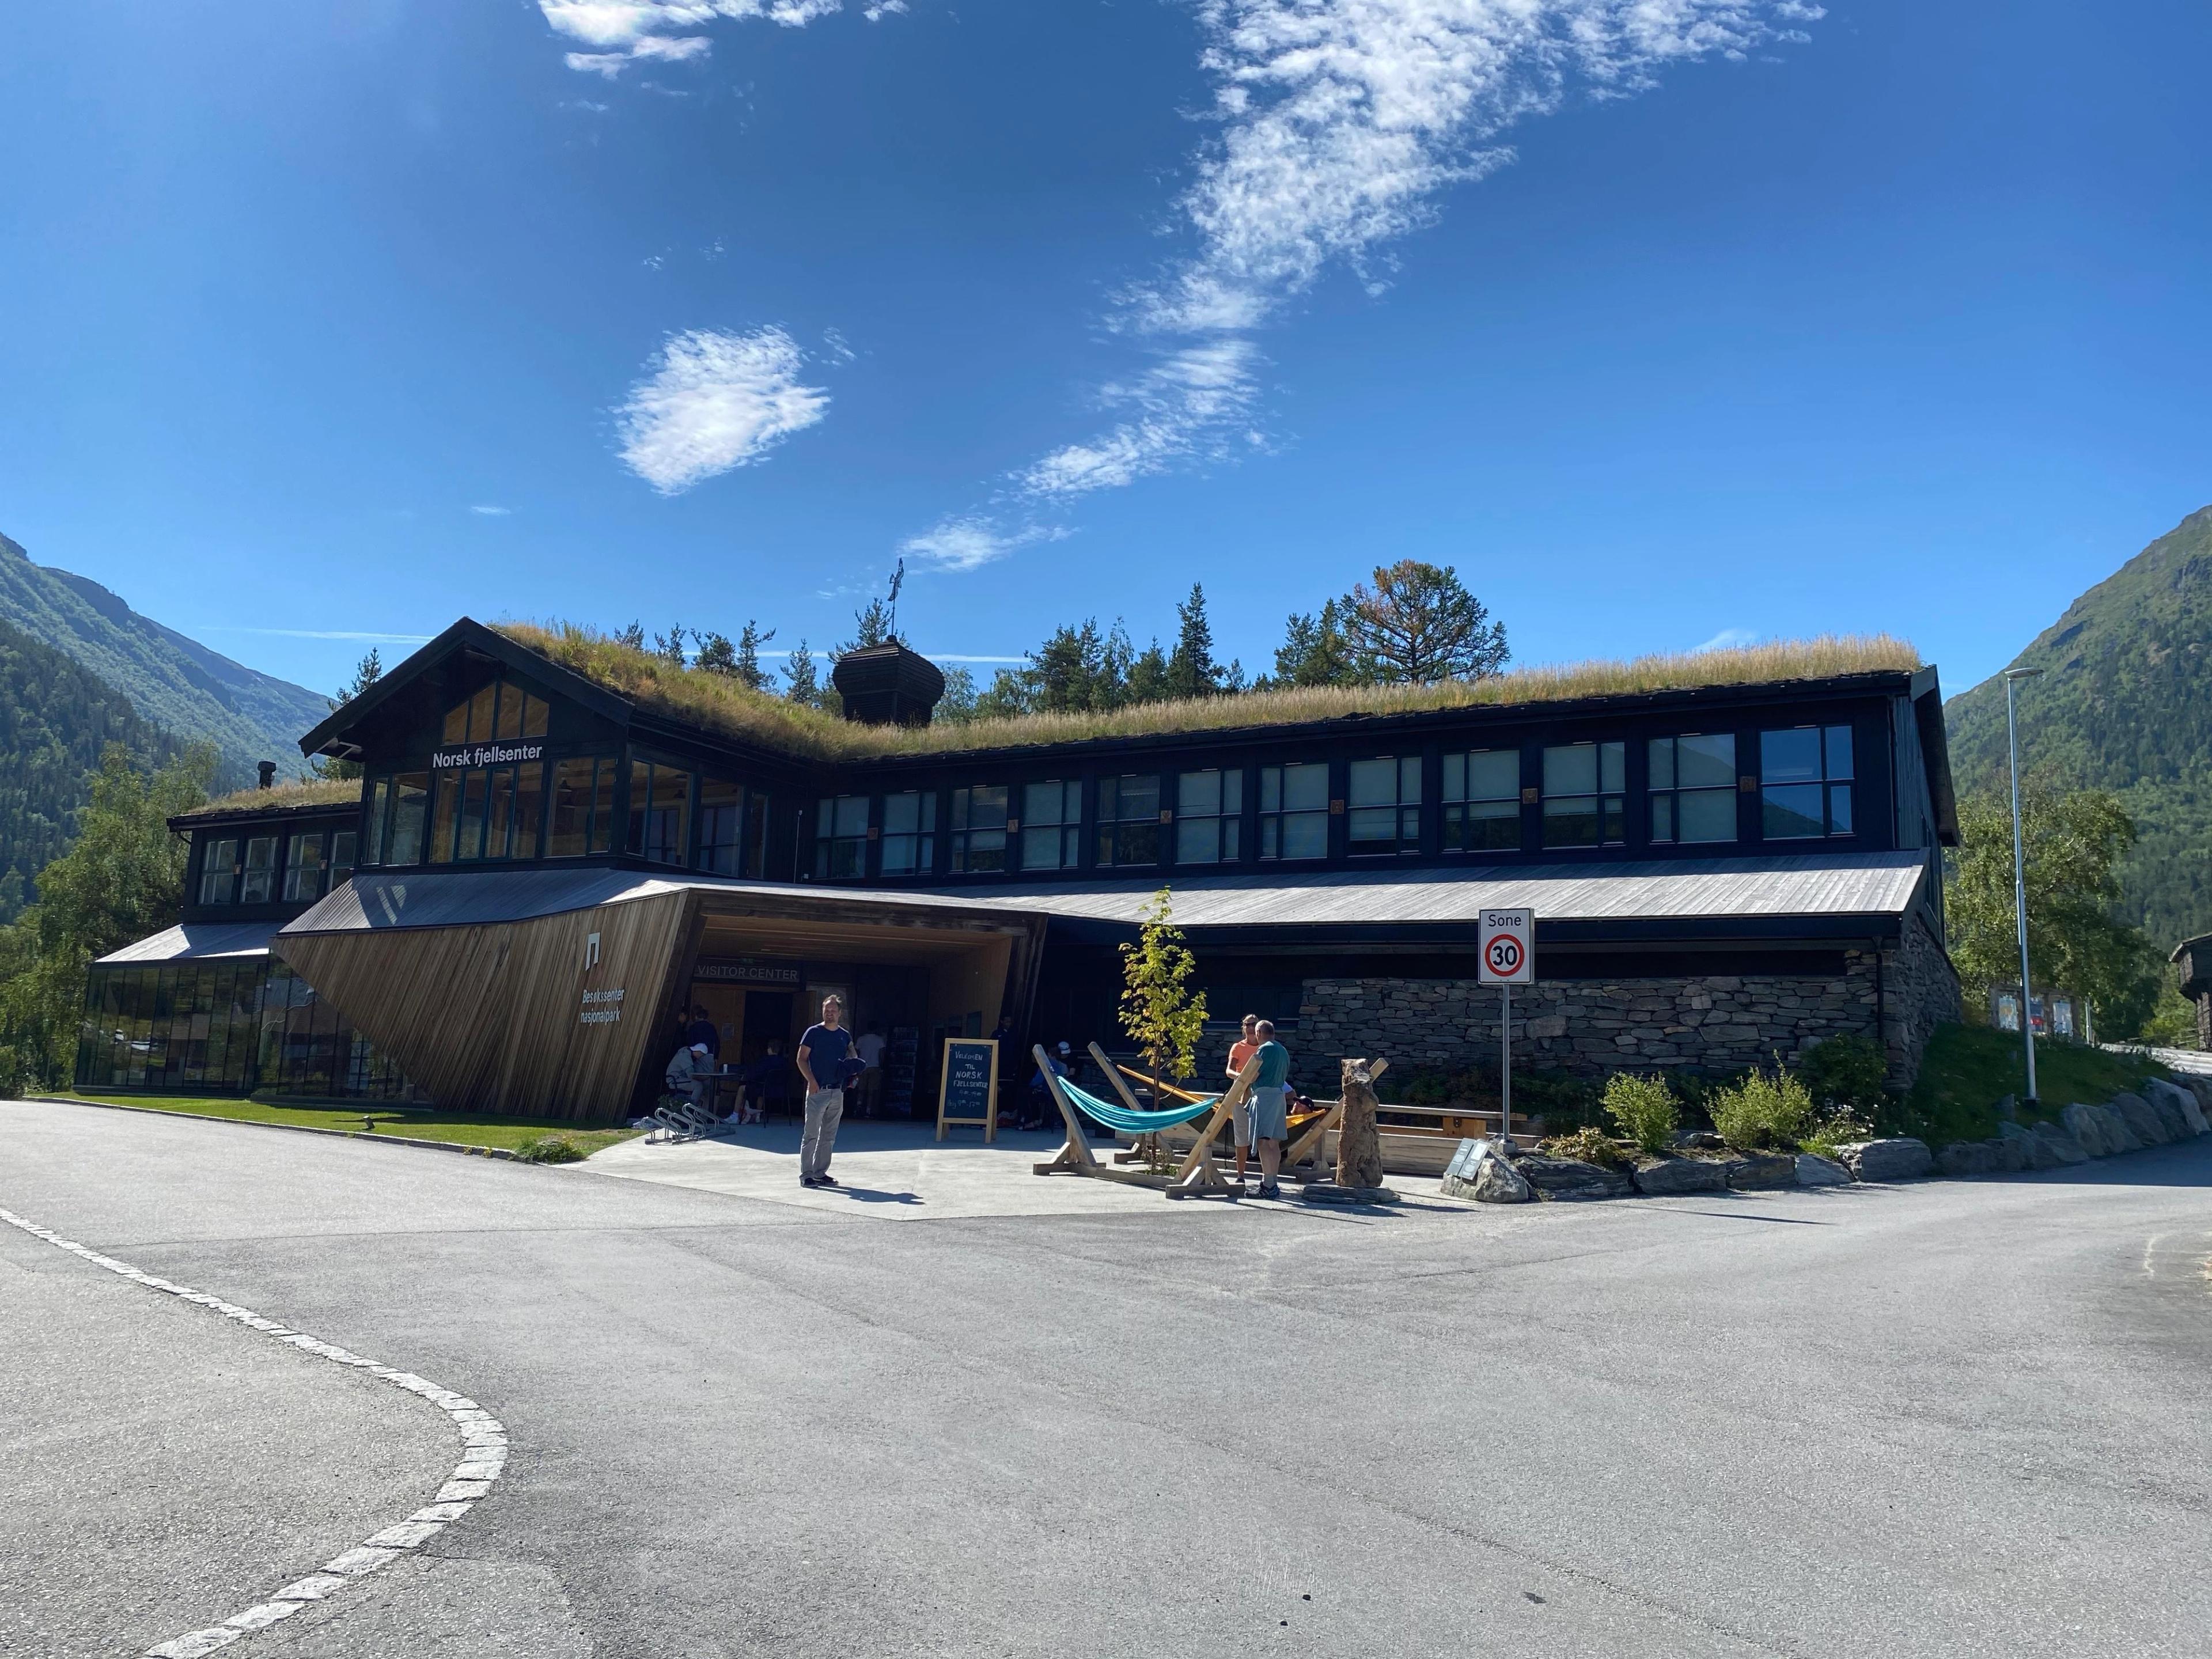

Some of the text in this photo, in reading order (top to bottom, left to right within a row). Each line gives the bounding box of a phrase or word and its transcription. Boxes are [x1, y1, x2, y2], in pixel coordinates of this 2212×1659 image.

[433, 745, 542, 768] Norsk fjellsenter
[1488, 914, 1521, 927] Sone
[1493, 945, 1517, 965] 30
[698, 965, 797, 979] VISITOR CENTER
[581, 1006, 620, 1027] nasjonalpark
[955, 1071, 982, 1079] NORSK
[953, 1080, 988, 1089] FJELLSENTER
